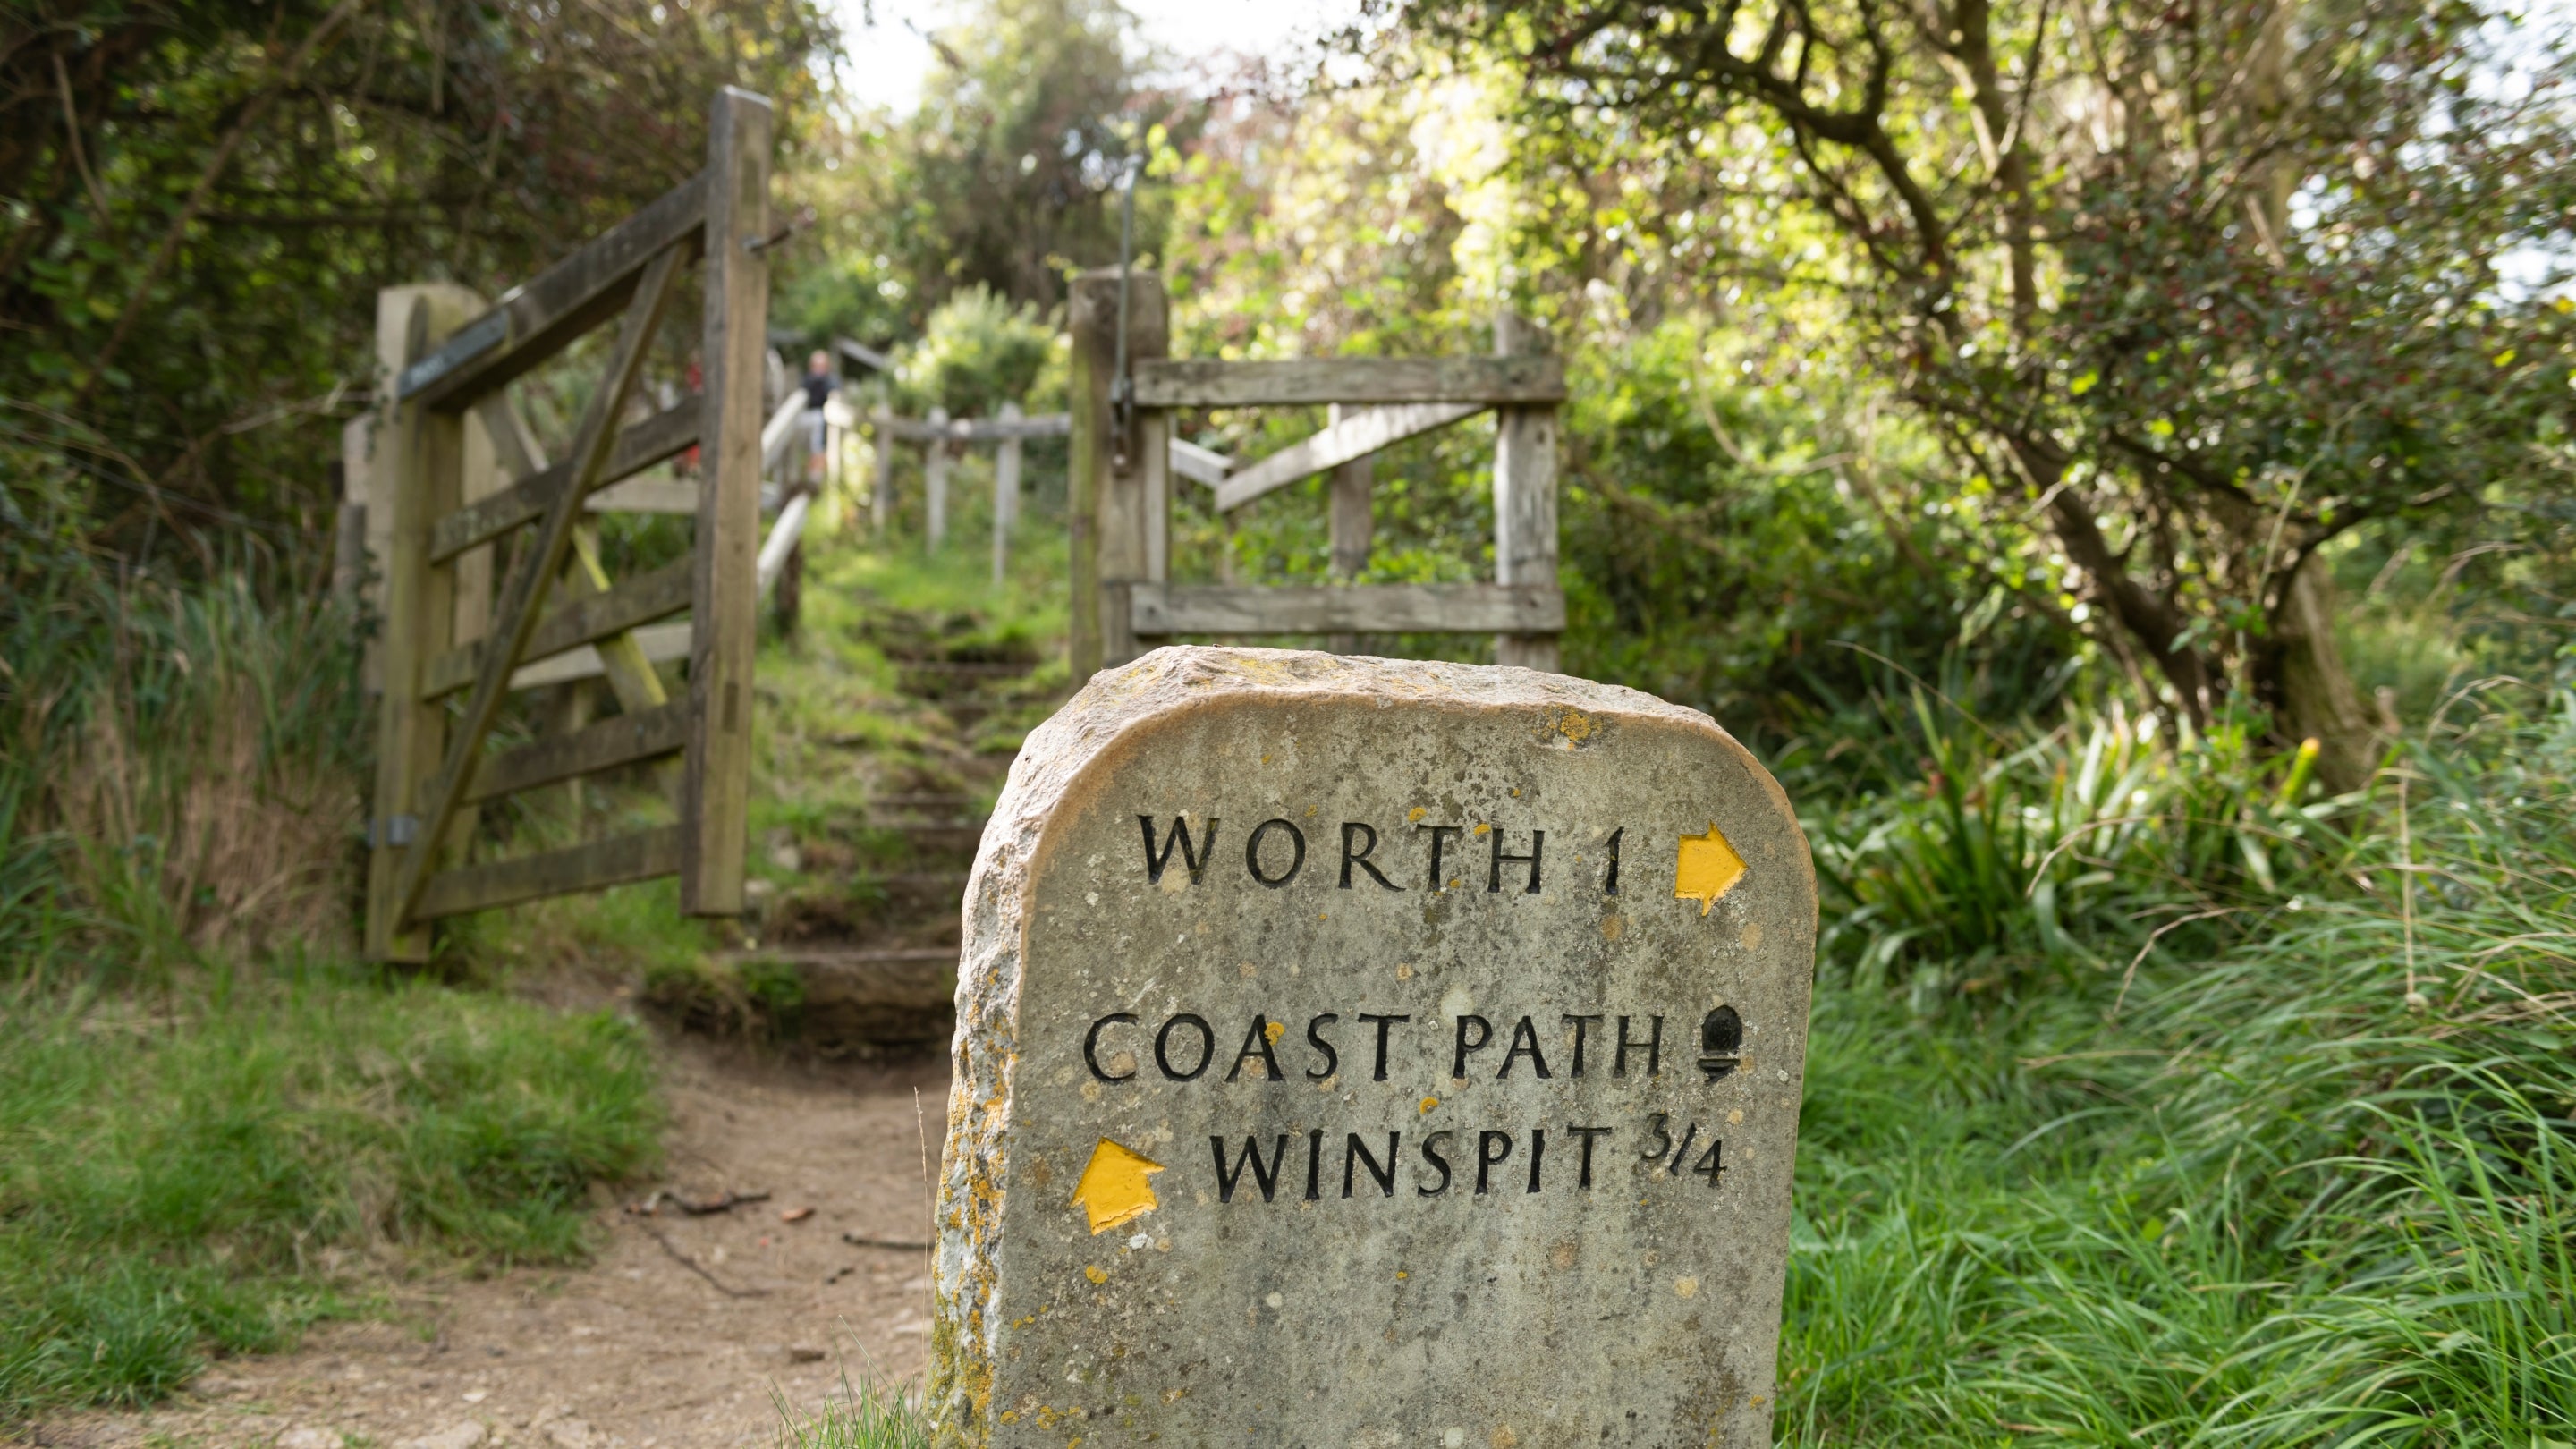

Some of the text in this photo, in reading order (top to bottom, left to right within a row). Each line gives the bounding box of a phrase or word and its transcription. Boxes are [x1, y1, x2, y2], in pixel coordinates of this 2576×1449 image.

[1138, 814, 1624, 894] WORTH 1
[1083, 1012, 1664, 1084] COAST PATH
[1209, 1112, 1729, 1204] WINSPIT 3/4
